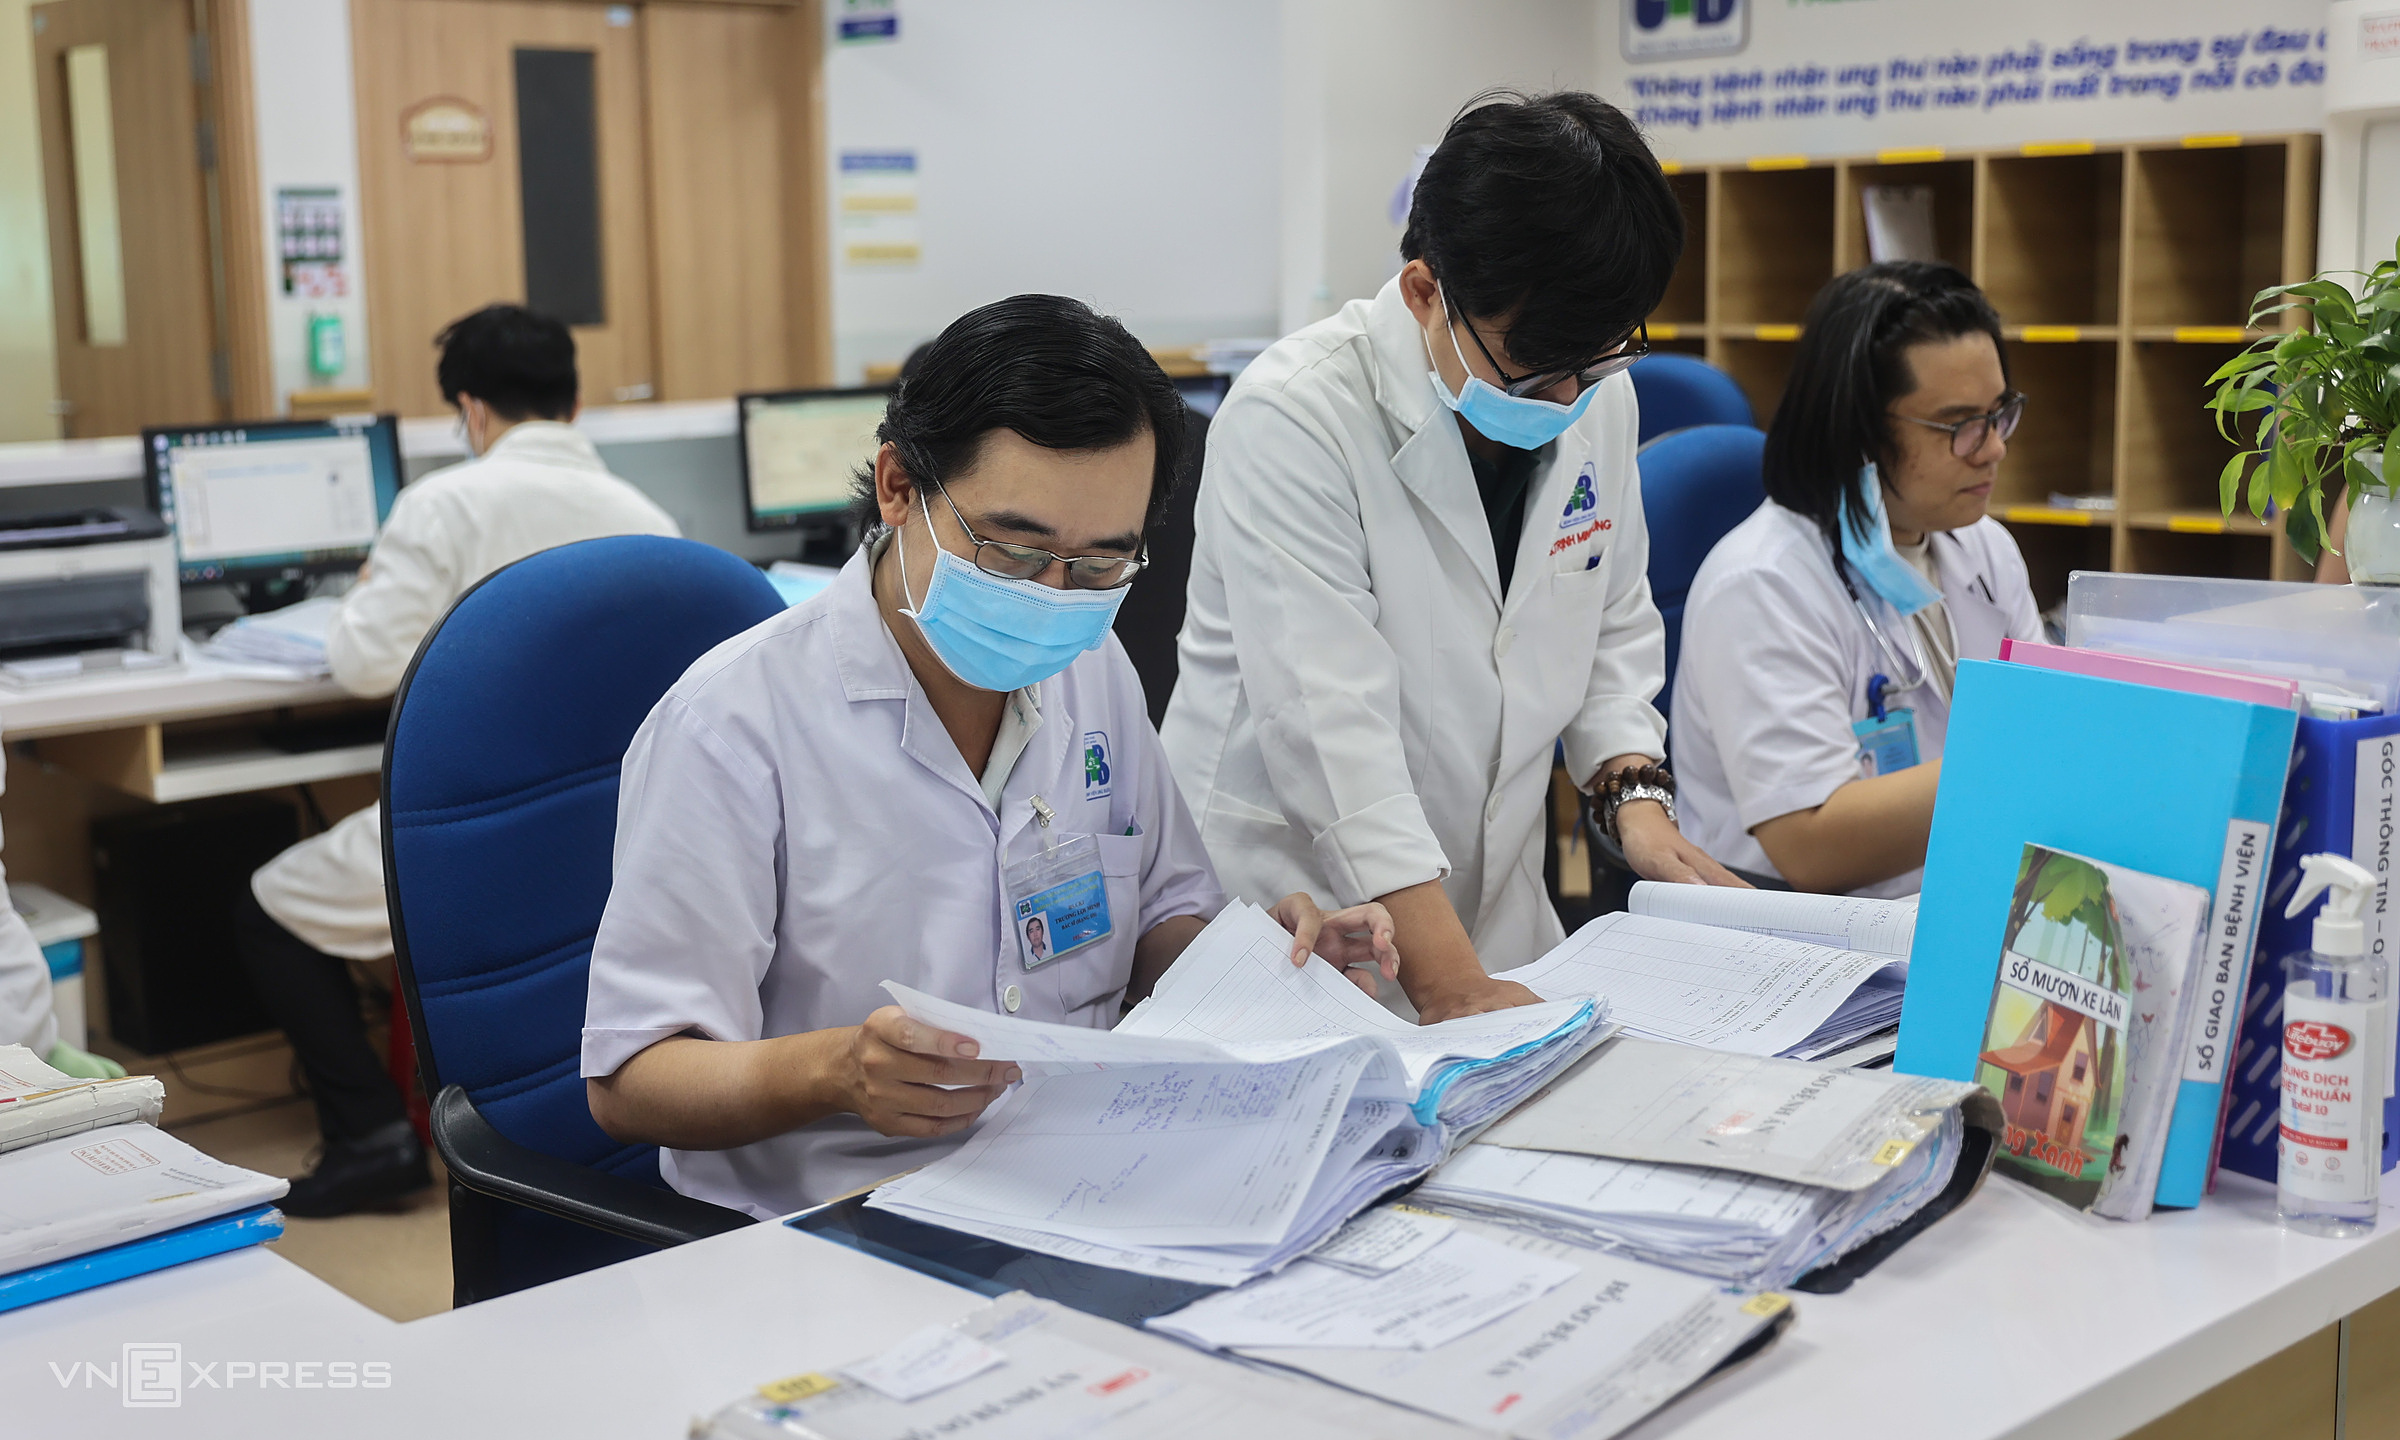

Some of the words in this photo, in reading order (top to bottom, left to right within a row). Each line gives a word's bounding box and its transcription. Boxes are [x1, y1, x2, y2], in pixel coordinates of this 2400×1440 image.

[2381, 741, 2395, 789] GÓC
[2236, 832, 2256, 879] VIỆN
[2377, 794, 2394, 873] THÔNG
[2224, 884, 2246, 939] BỆNH
[2375, 879, 2389, 914] TIN
[2010, 957, 2031, 981] SỔ
[2032, 970, 2080, 1002] MƯỢN
[2081, 989, 2098, 1010] XE
[2216, 943, 2235, 985] BAN
[2204, 989, 2225, 1039] GIAO
[2285, 1027, 2345, 1052] Lifebuoy
[2283, 1061, 2310, 1081] DUNG
[2313, 1072, 2349, 1086] DỊCH
[2291, 1097, 2312, 1113] Total
[2315, 1104, 2328, 1116] 10
[2030, 1129, 2085, 1178] Xanh
